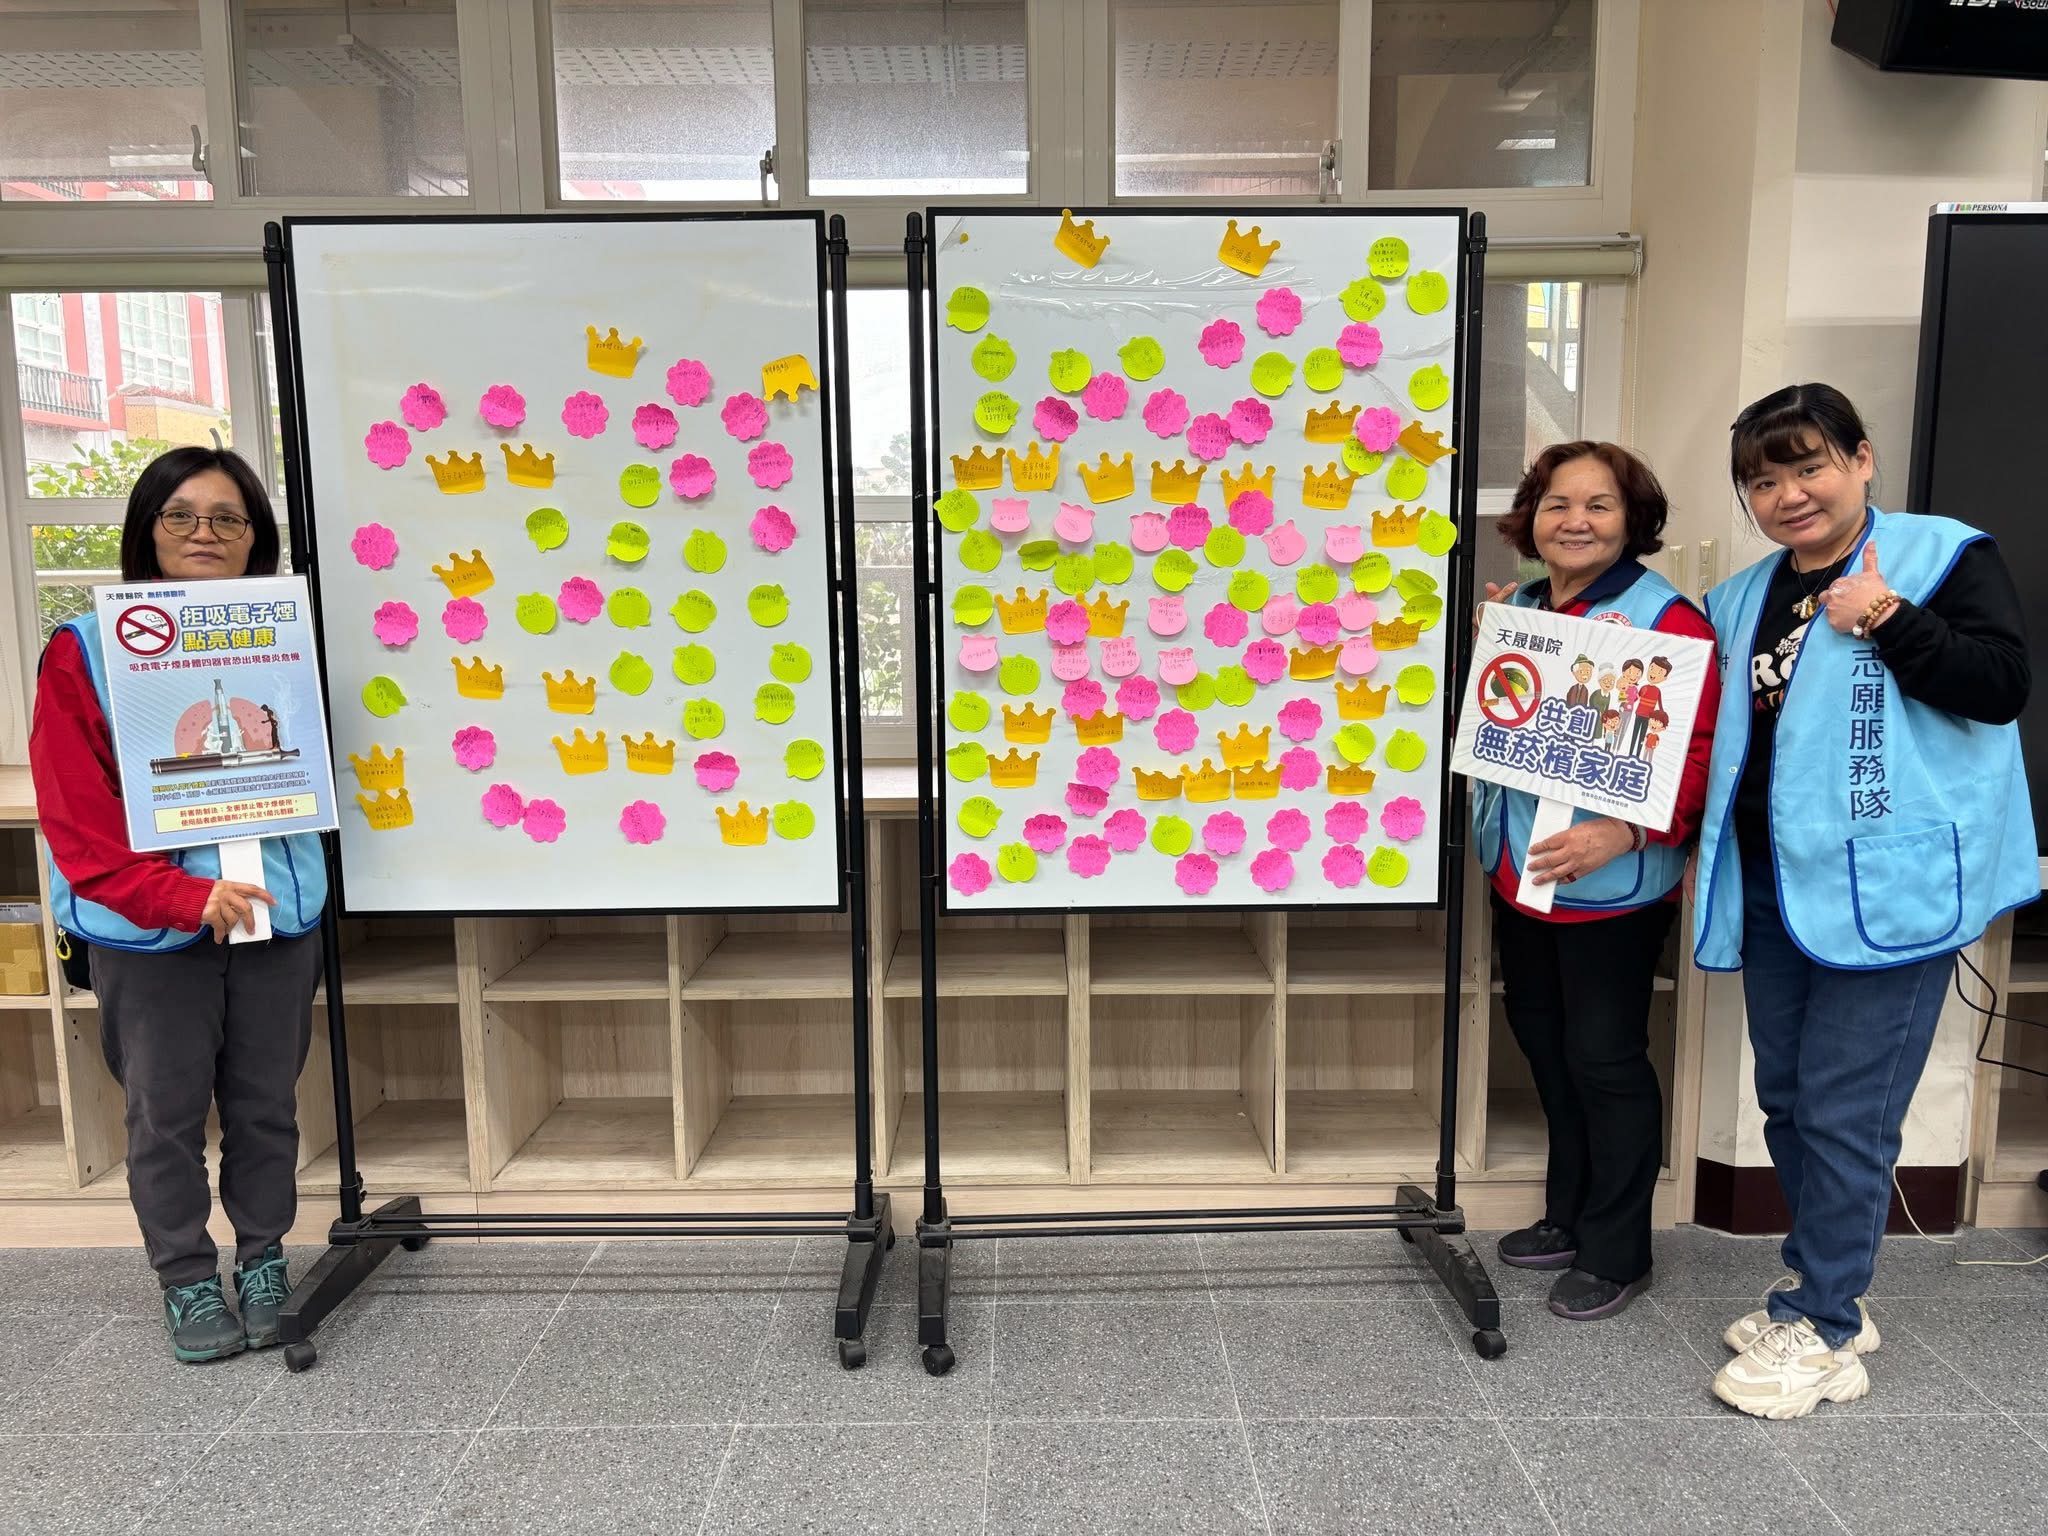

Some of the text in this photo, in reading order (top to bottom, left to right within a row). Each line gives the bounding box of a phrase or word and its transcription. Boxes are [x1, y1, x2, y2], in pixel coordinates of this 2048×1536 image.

[1972, 203, 2008, 212] PERSONA
[106, 592, 143, 600] 天晟醫院
[180, 601, 296, 627] 拒吸電子煙
[182, 627, 276, 652] 點亮健康
[1495, 628, 1563, 656] 天晟醫院
[1538, 699, 1597, 741] 共創
[1849, 646, 1893, 821] 志願服務隊
[1475, 723, 1651, 800] 無菸檳家庭
